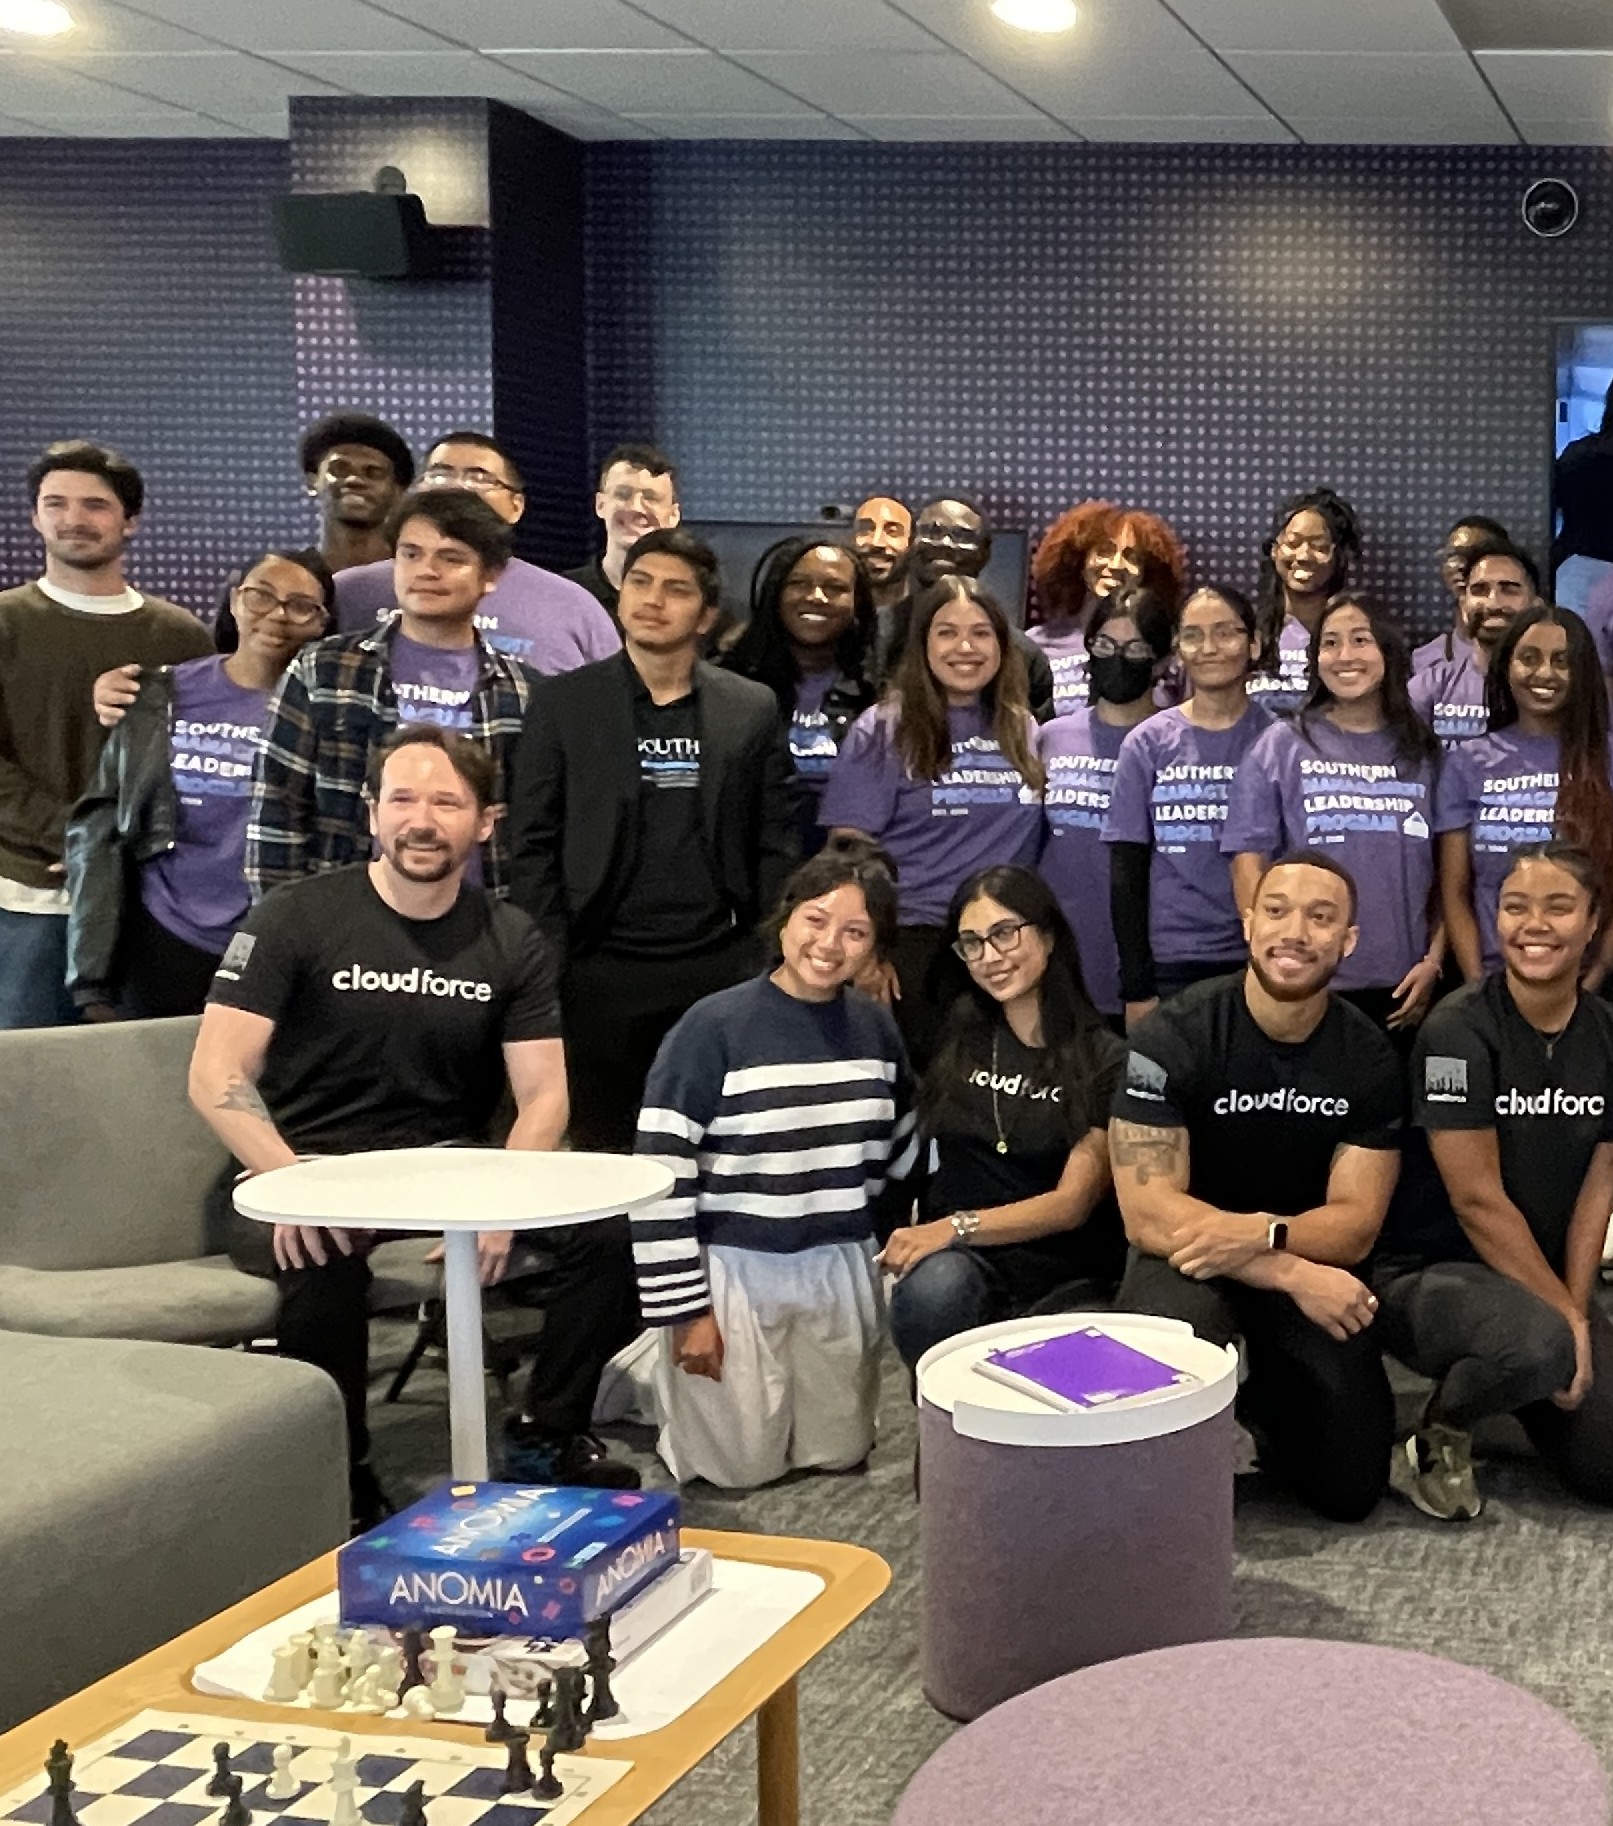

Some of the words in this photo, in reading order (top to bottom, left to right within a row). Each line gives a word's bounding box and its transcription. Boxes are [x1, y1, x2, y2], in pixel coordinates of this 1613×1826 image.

[1300, 760, 1397, 780] SOUTHERN
[1304, 795, 1414, 813] LEADERSHIP
[1306, 814, 1398, 833] PROGRAM
[331, 963, 493, 1002] cloudforce
[1213, 1087, 1350, 1117] cloudforce
[594, 1530, 668, 1607] ANOMIA
[389, 1570, 530, 1617] ANOMIA
